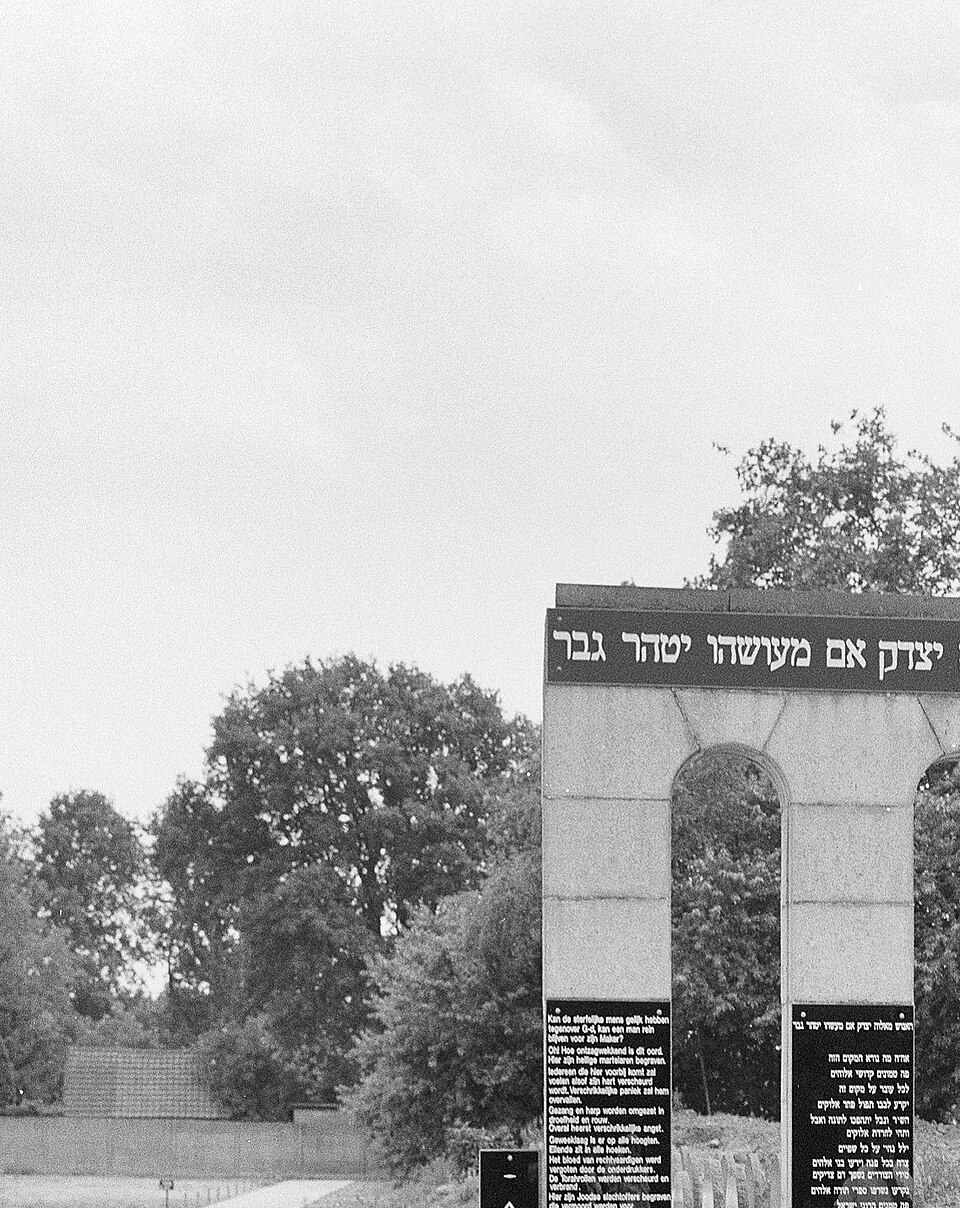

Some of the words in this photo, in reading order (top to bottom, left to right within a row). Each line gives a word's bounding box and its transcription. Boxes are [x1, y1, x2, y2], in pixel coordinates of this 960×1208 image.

[554, 630, 606, 662] גבר
[622, 633, 693, 664] יטהר
[826, 636, 866, 669] אם
[878, 640, 944, 681] יצדק
[548, 1015, 561, 1023] Kan
[563, 1015, 571, 1023] de
[626, 1016, 643, 1025] gelijk
[645, 1016, 670, 1024] hebben
[548, 1026, 580, 1034] tegenover
[598, 1025, 610, 1033] kan
[642, 1026, 655, 1034] rein
[548, 1035, 569, 1044] blijven
[587, 1035, 598, 1044] zijn
[600, 1035, 624, 1043] Maker?
[561, 1046, 575, 1055] Hoe
[628, 1047, 635, 1055] is
[636, 1047, 645, 1055] dit
